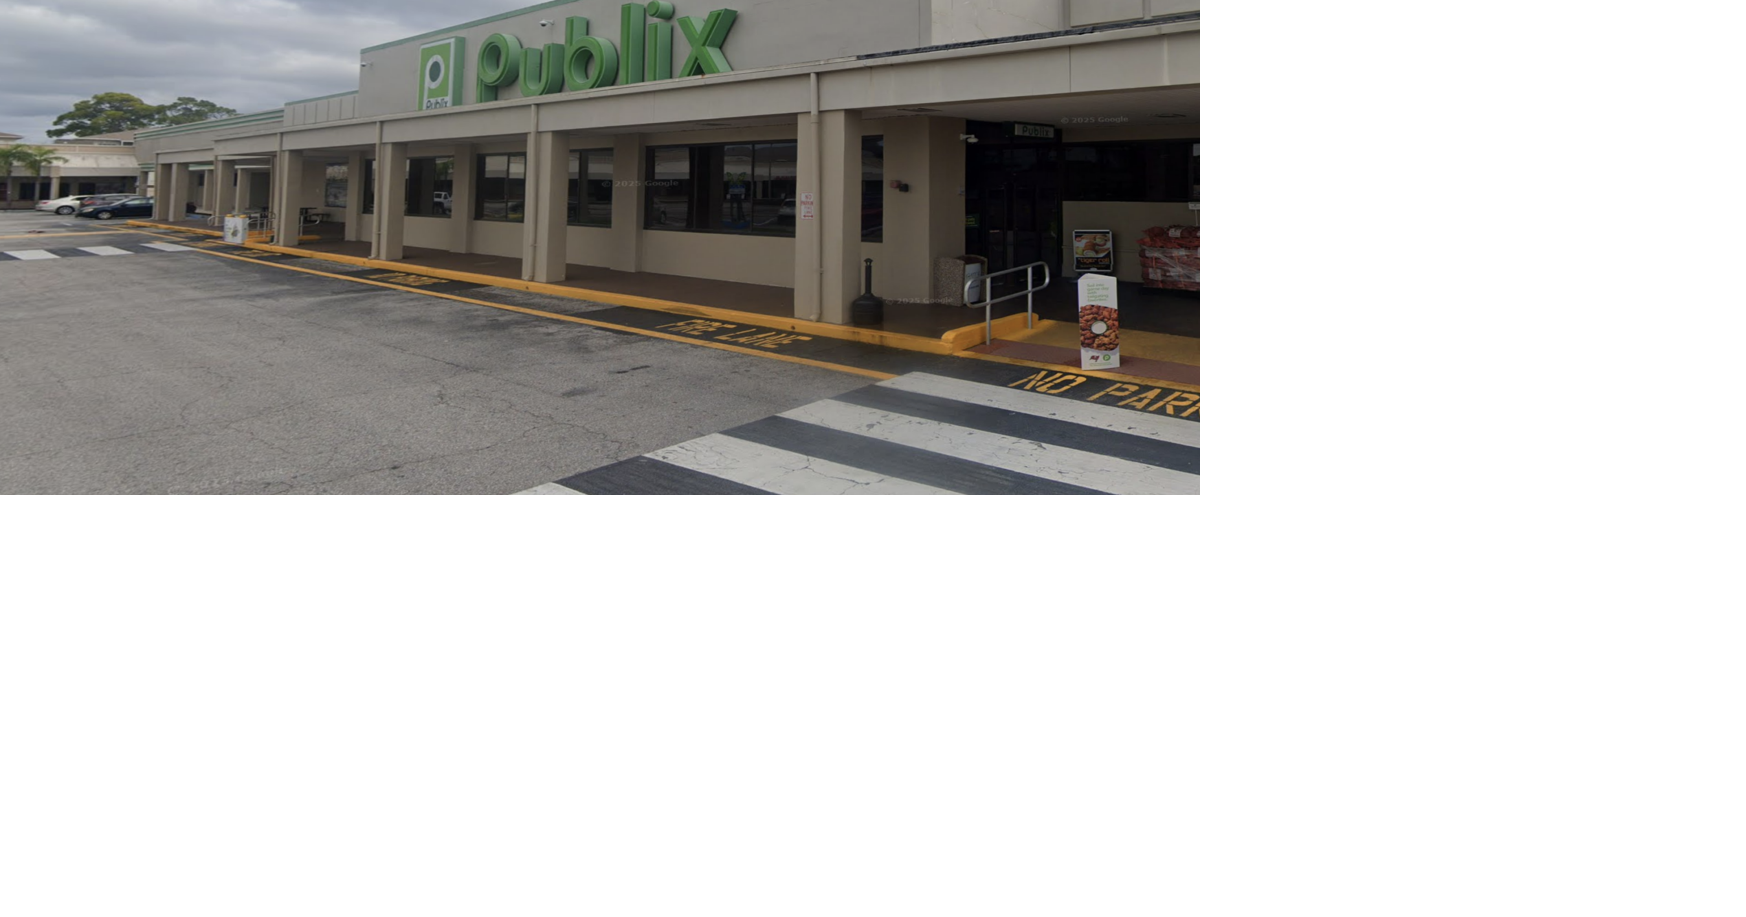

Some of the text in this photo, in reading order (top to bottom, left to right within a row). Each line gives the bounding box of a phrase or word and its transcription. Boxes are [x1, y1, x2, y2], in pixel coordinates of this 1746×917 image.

[477, 1, 738, 103] Publix
[1022, 125, 1050, 137] Publix
[655, 319, 814, 349] FIRE LANE
[1008, 370, 1087, 394] NO
